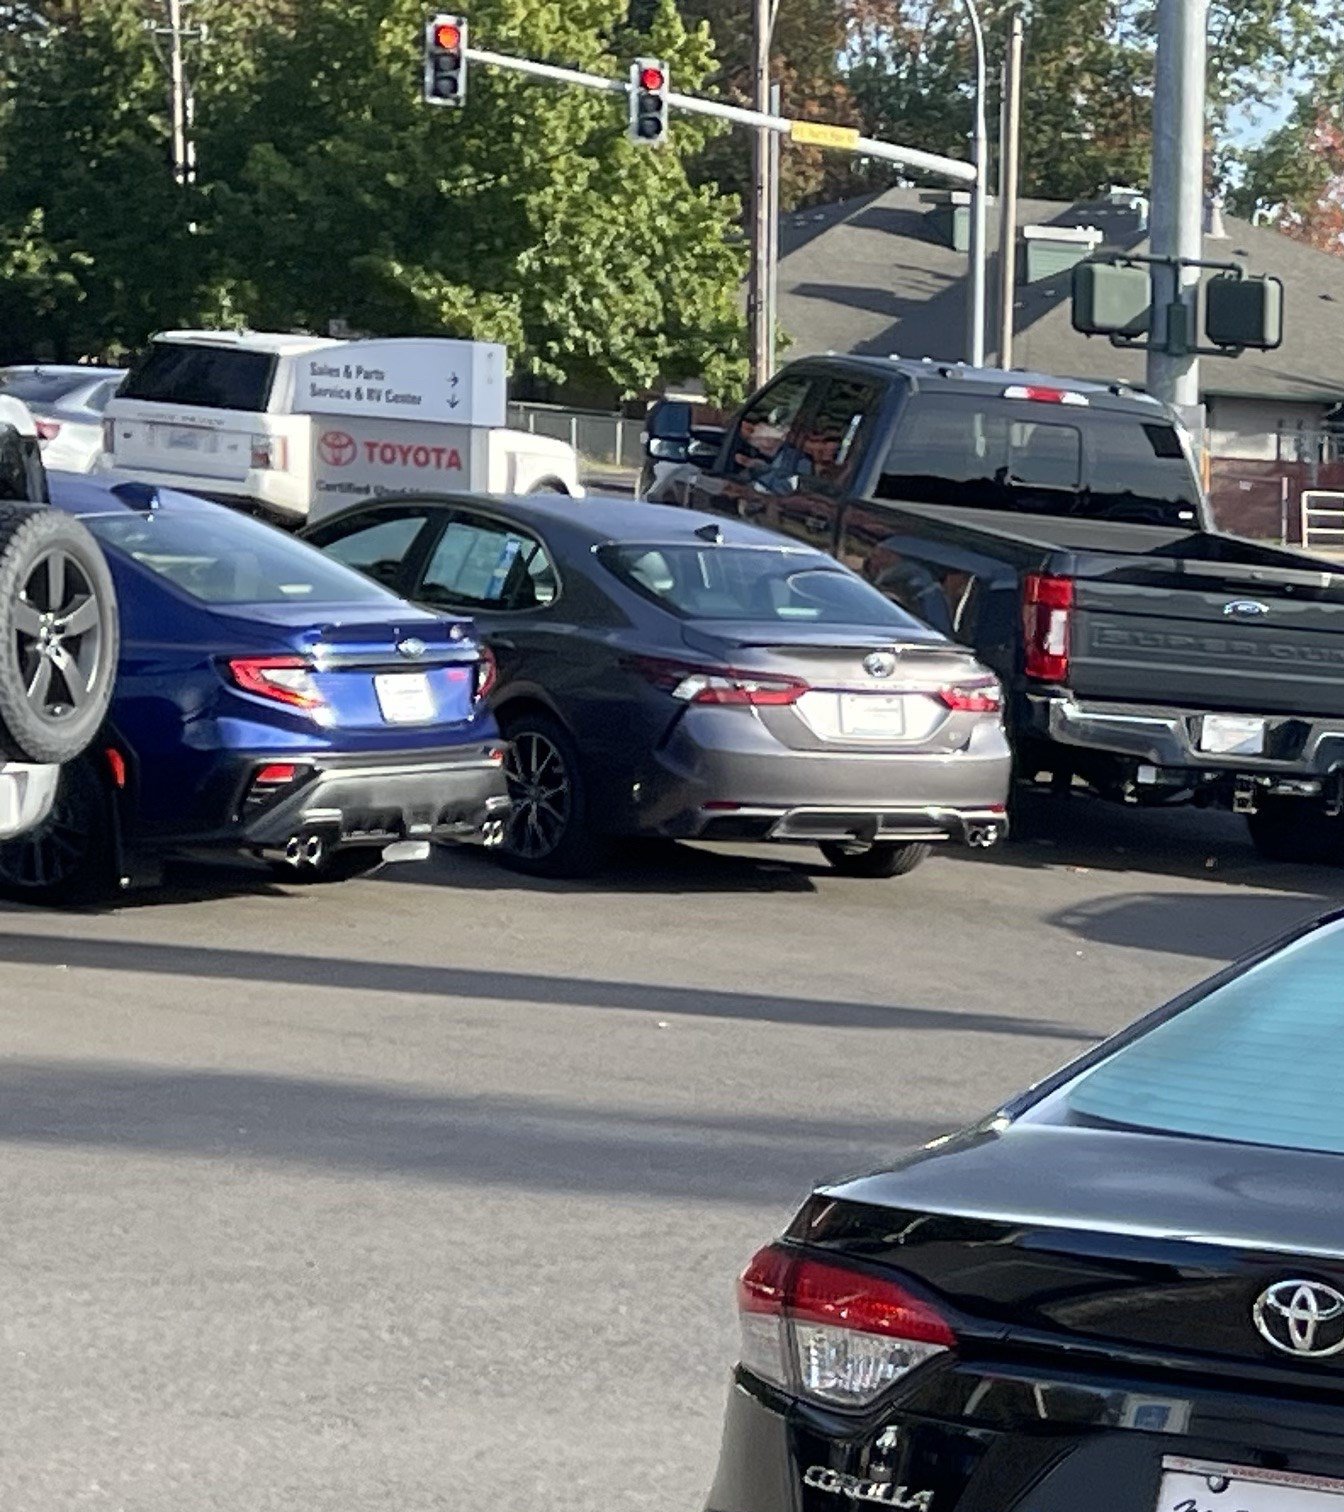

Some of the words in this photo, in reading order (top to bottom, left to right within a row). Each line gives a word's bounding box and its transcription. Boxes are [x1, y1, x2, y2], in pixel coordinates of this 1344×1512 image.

[310, 361, 340, 378] Sales
[342, 364, 352, 379] &
[355, 365, 385, 381] Parts
[310, 383, 351, 400] Service
[354, 387, 363, 401] &
[385, 389, 422, 405] Center
[363, 441, 463, 471] TOYOTA
[315, 479, 371, 495] Certified
